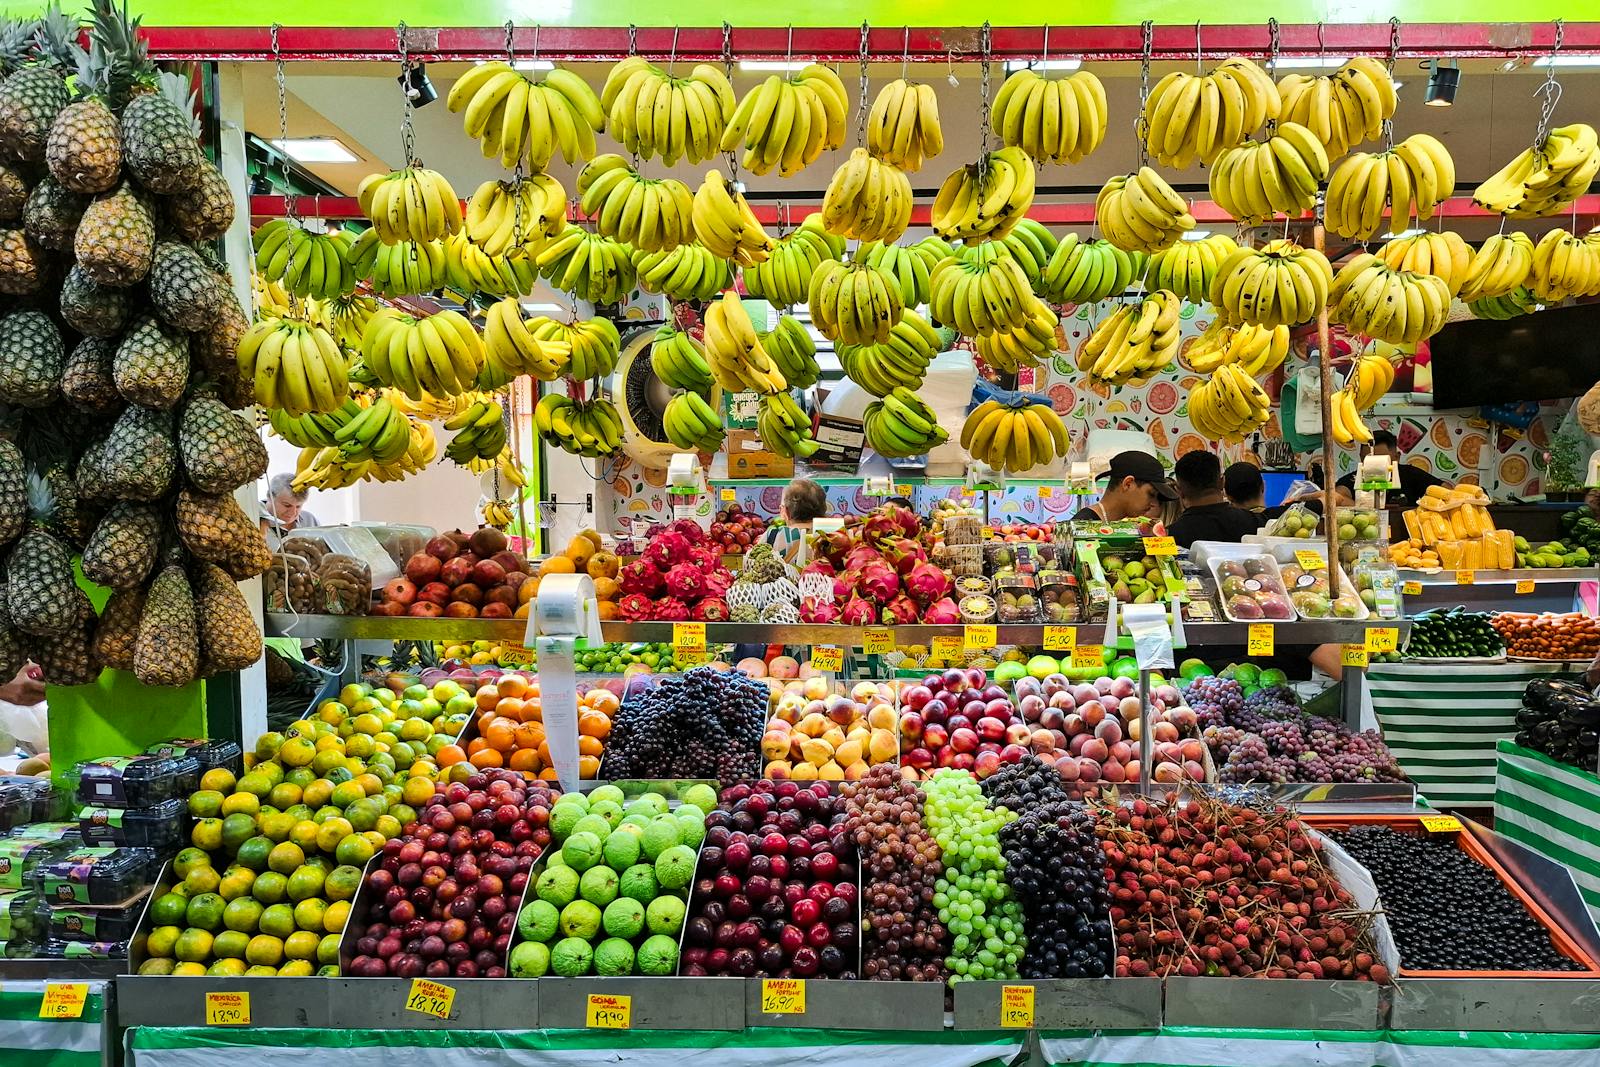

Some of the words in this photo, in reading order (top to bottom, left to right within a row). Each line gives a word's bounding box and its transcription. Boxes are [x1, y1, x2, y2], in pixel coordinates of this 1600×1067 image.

[1050, 625, 1068, 633] FIGO
[416, 981, 446, 993] AMEIXA
[767, 981, 797, 989] AMEIXA
[408, 993, 446, 1012] 18,90
[590, 995, 617, 1004] GOIABA
[763, 995, 795, 1010] 16,90
[212, 1009, 241, 1022] 18,90
[595, 1010, 624, 1026] 19,90
[1006, 1010, 1030, 1023] 18,90
